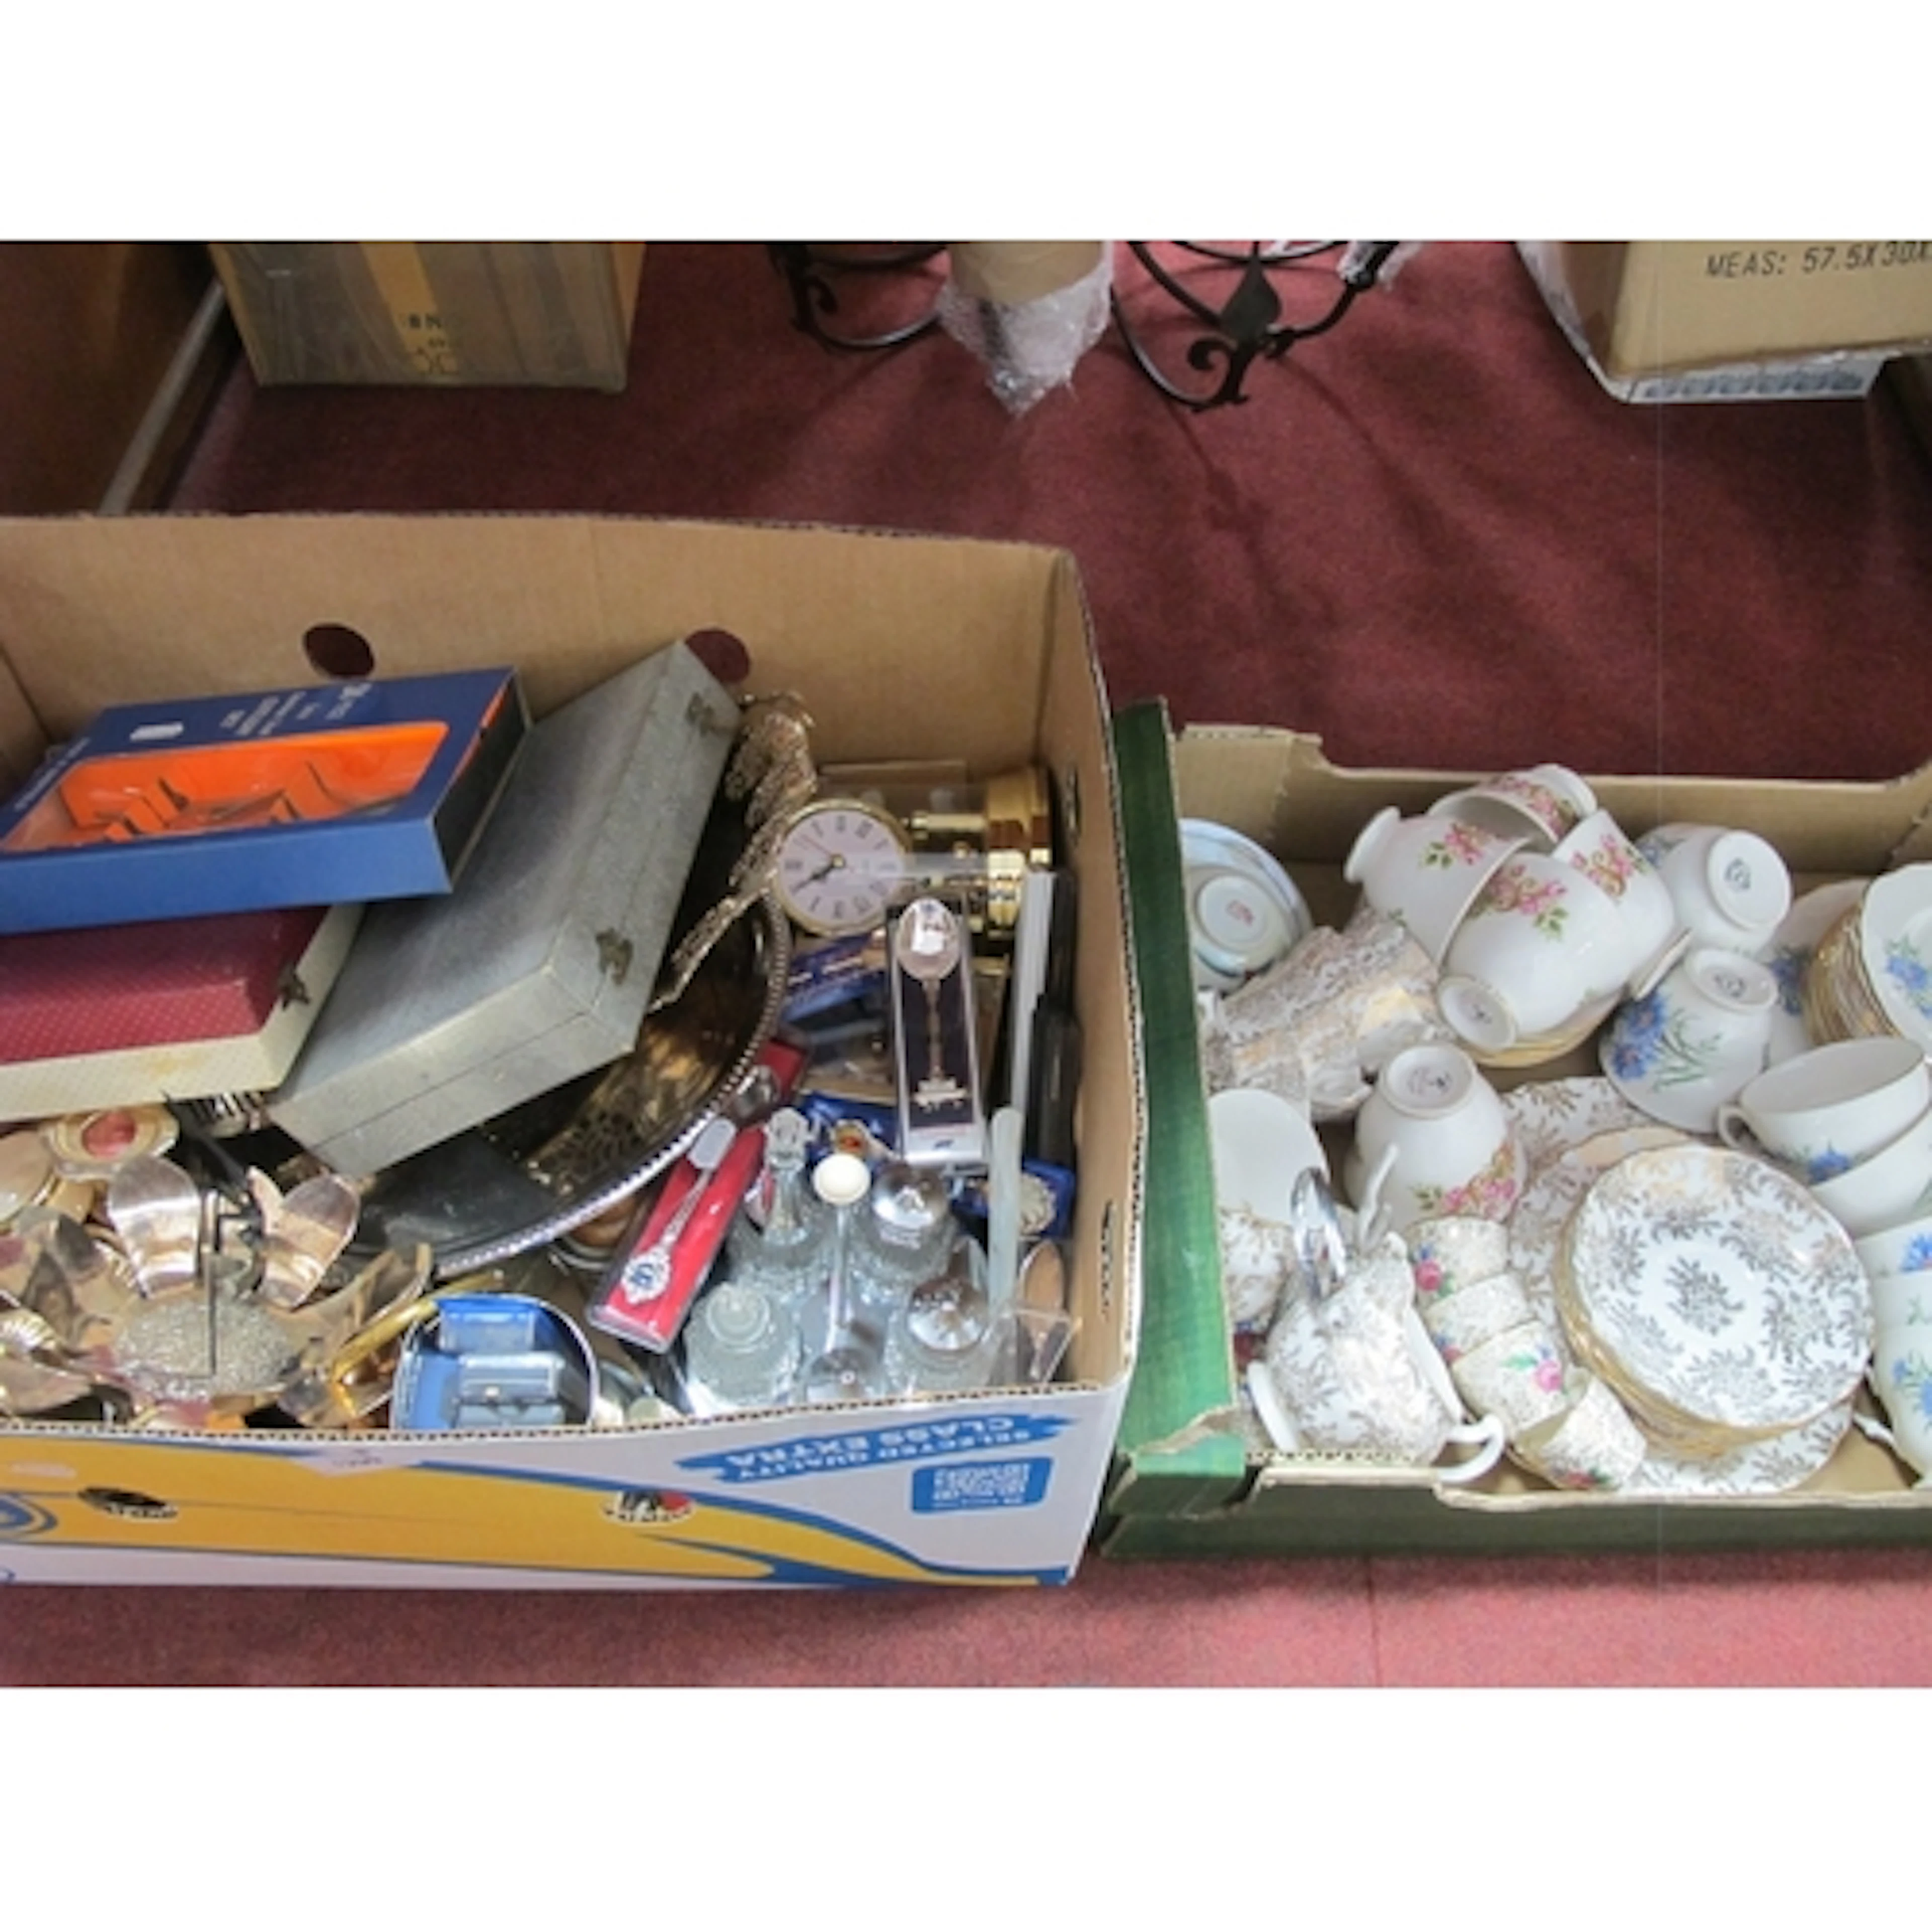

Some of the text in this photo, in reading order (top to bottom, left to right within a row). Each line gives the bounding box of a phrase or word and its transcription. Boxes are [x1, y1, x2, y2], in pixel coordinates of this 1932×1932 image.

[1706, 251, 1787, 278] MEAS:
[726, 1416, 1014, 1467] CLASS EXTRA
[739, 1450, 870, 1479] QUALITY
